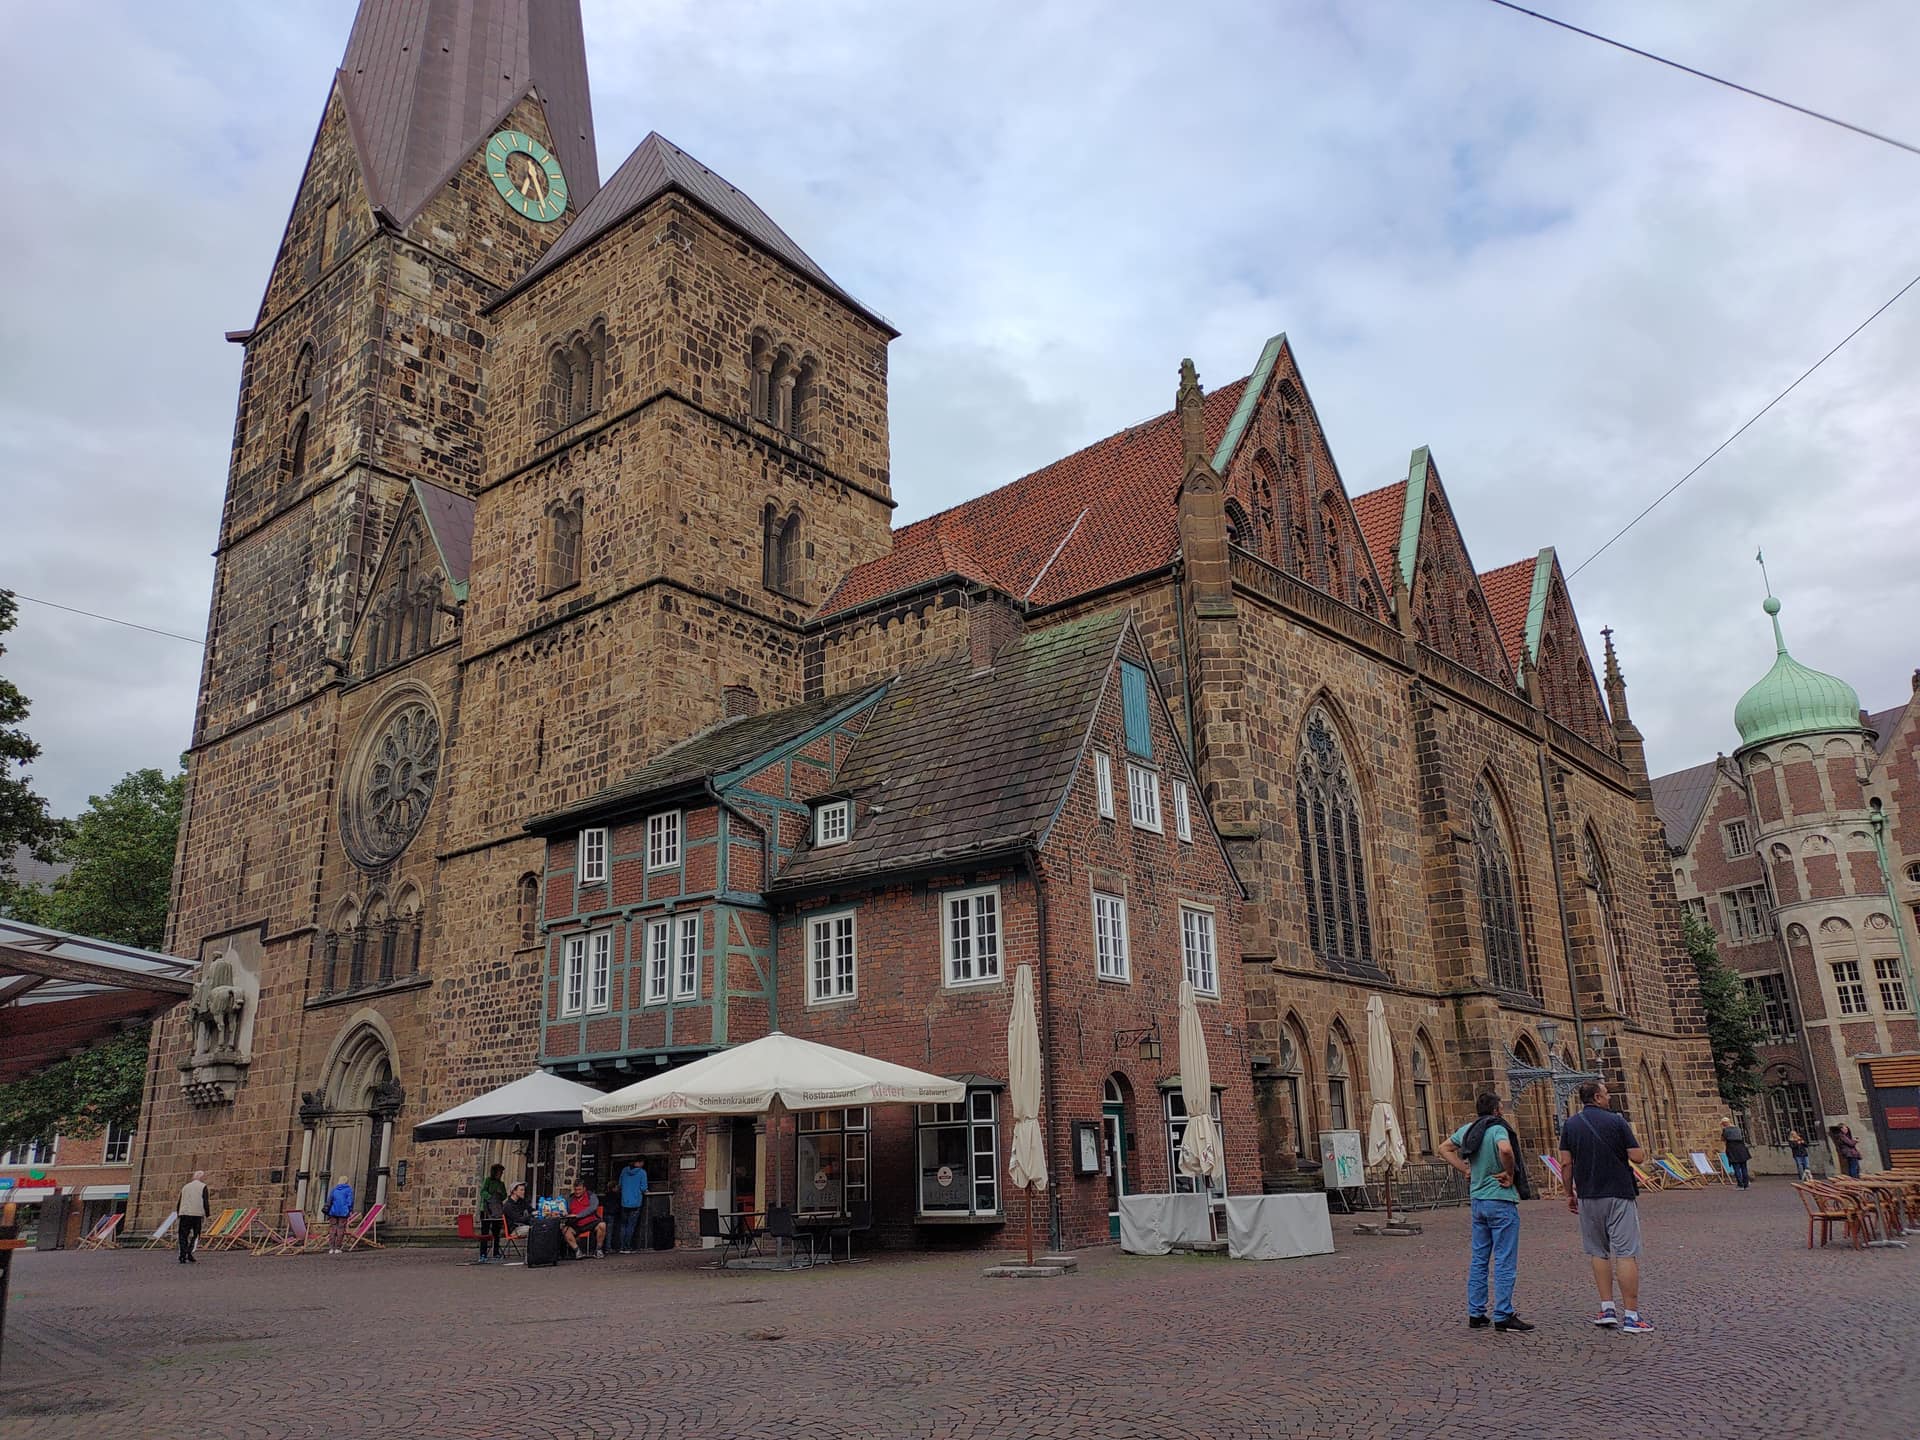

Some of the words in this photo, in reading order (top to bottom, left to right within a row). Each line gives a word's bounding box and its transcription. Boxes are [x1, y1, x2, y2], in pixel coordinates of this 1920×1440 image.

[802, 1088, 857, 1101] Rostbratwurst
[870, 1084, 905, 1098] Kiefert
[918, 1087, 948, 1097] Bratwurst
[589, 1102, 638, 1115] Rostbratwurst
[698, 1095, 763, 1106] Schinkenkrakauer
